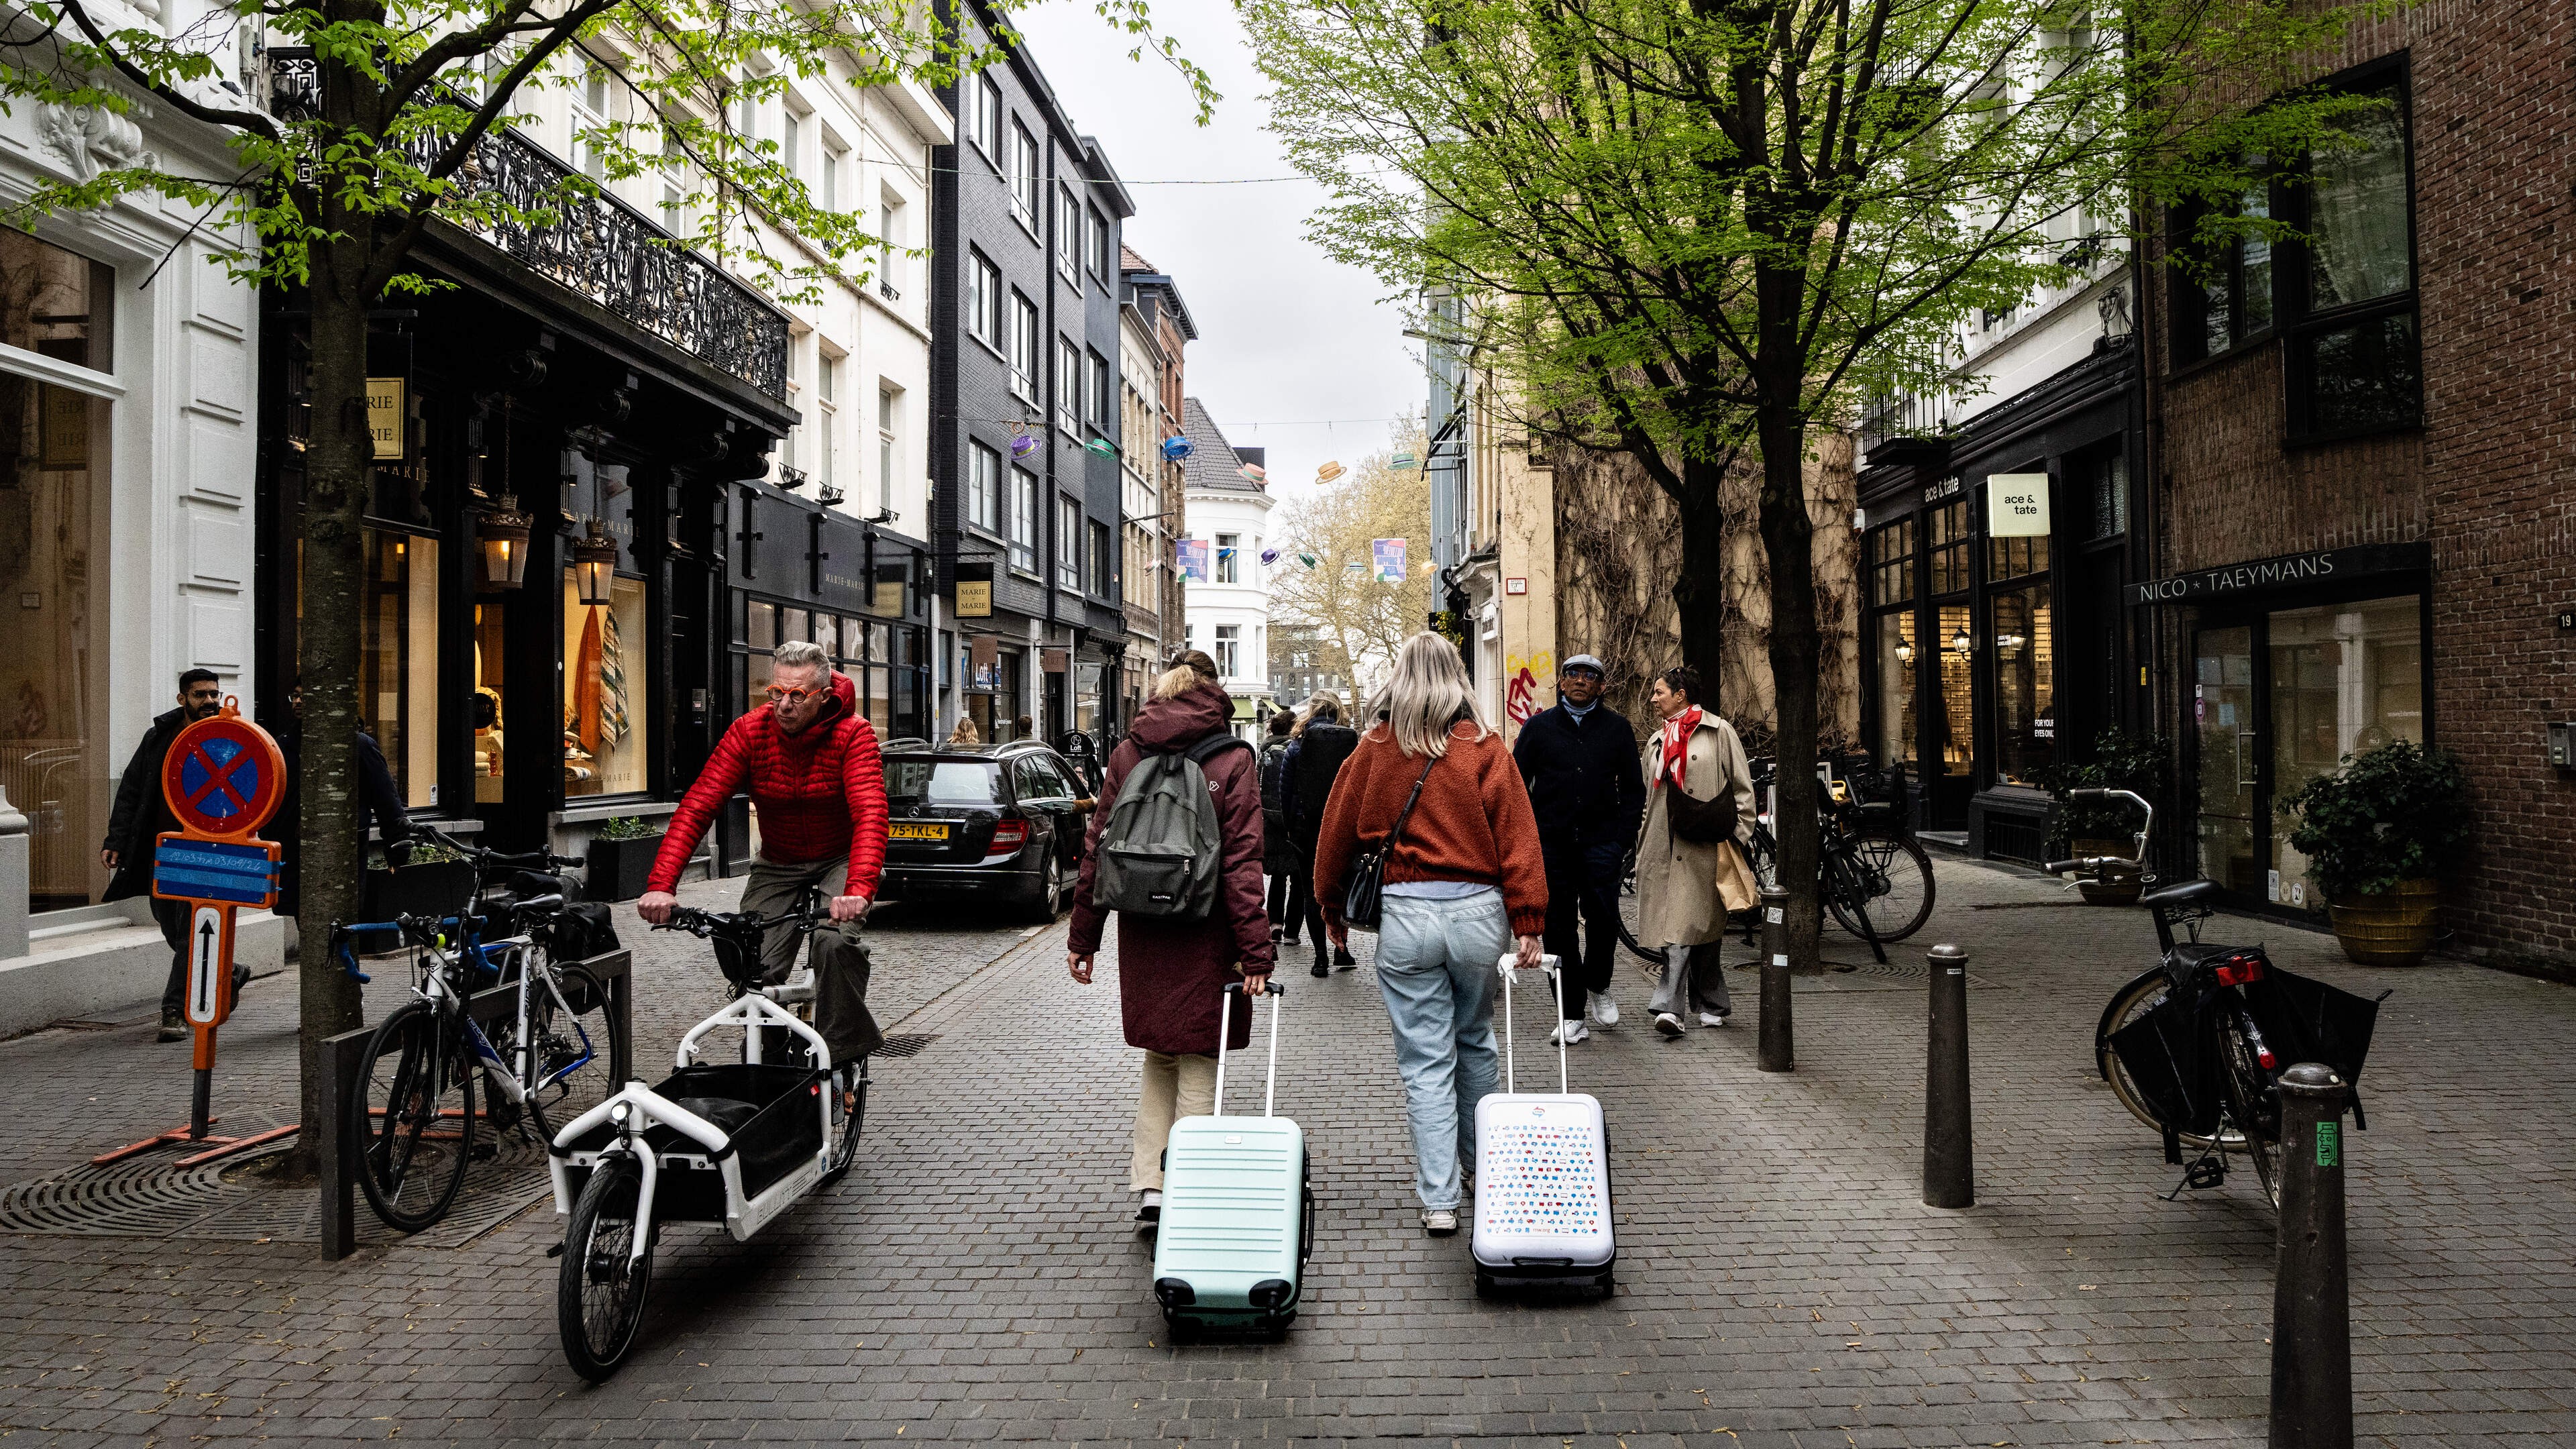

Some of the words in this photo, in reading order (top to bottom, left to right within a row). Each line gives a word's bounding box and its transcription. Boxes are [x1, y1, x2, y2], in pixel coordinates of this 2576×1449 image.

[367, 396, 393, 409] RIE
[368, 428, 392, 441] RIE
[1925, 485, 1937, 502] ace
[1939, 480, 1944, 498] &
[1944, 475, 1959, 494] tate
[2004, 496, 2025, 504] ace
[2027, 494, 2035, 503] &
[2015, 505, 2037, 515] tate
[2140, 579, 2186, 602] NICO
[2207, 553, 2333, 591] TAEYMANS
[2561, 614, 2571, 627] 19
[975, 662, 988, 682] Loft
[2035, 729, 2045, 737] EYES
[2045, 729, 2054, 737] ONL
[892, 824, 944, 837] 75-TKL-4
